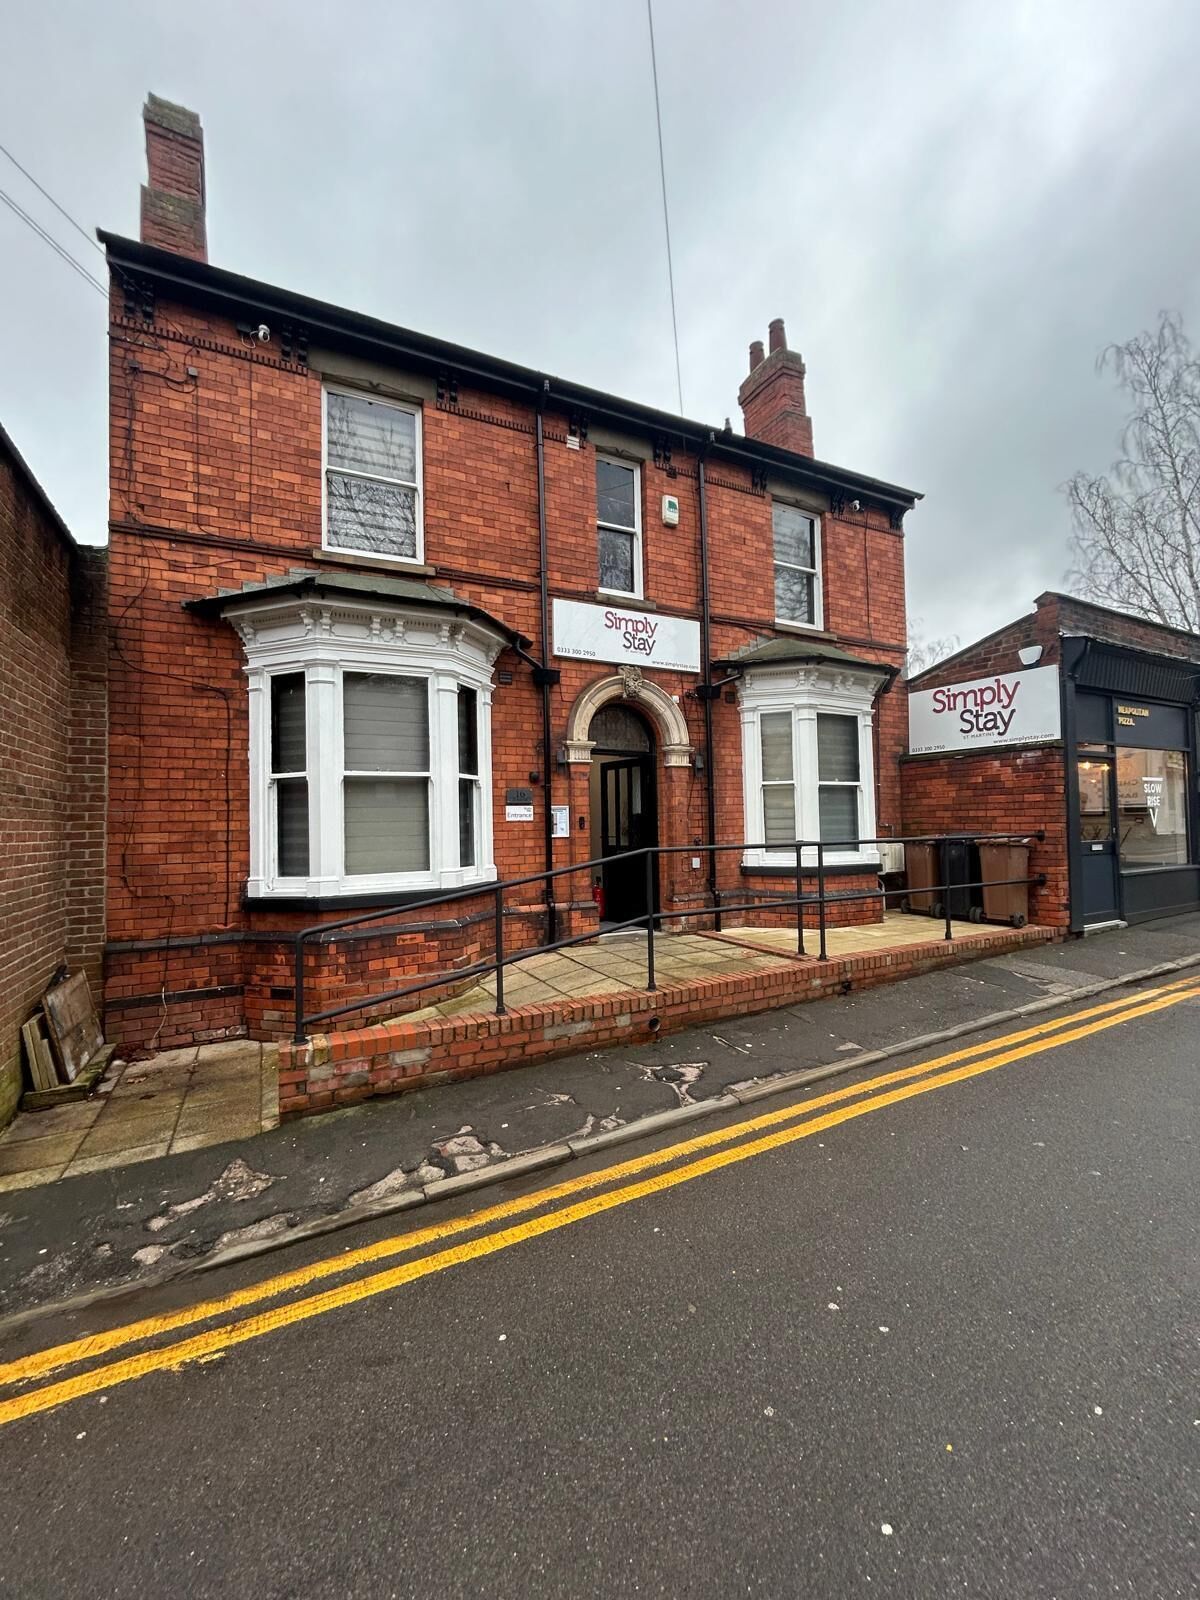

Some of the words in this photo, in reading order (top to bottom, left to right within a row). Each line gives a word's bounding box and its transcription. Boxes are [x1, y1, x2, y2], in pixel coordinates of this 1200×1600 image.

[604, 611, 658, 638] Simply
[622, 631, 656, 656] Stay
[932, 679, 1020, 713] Simply
[960, 708, 1016, 736] Stay
[993, 733, 1054, 743] www.simplystay.com
[1143, 783, 1162, 793] SLOW
[1147, 796, 1160, 806] RISE
